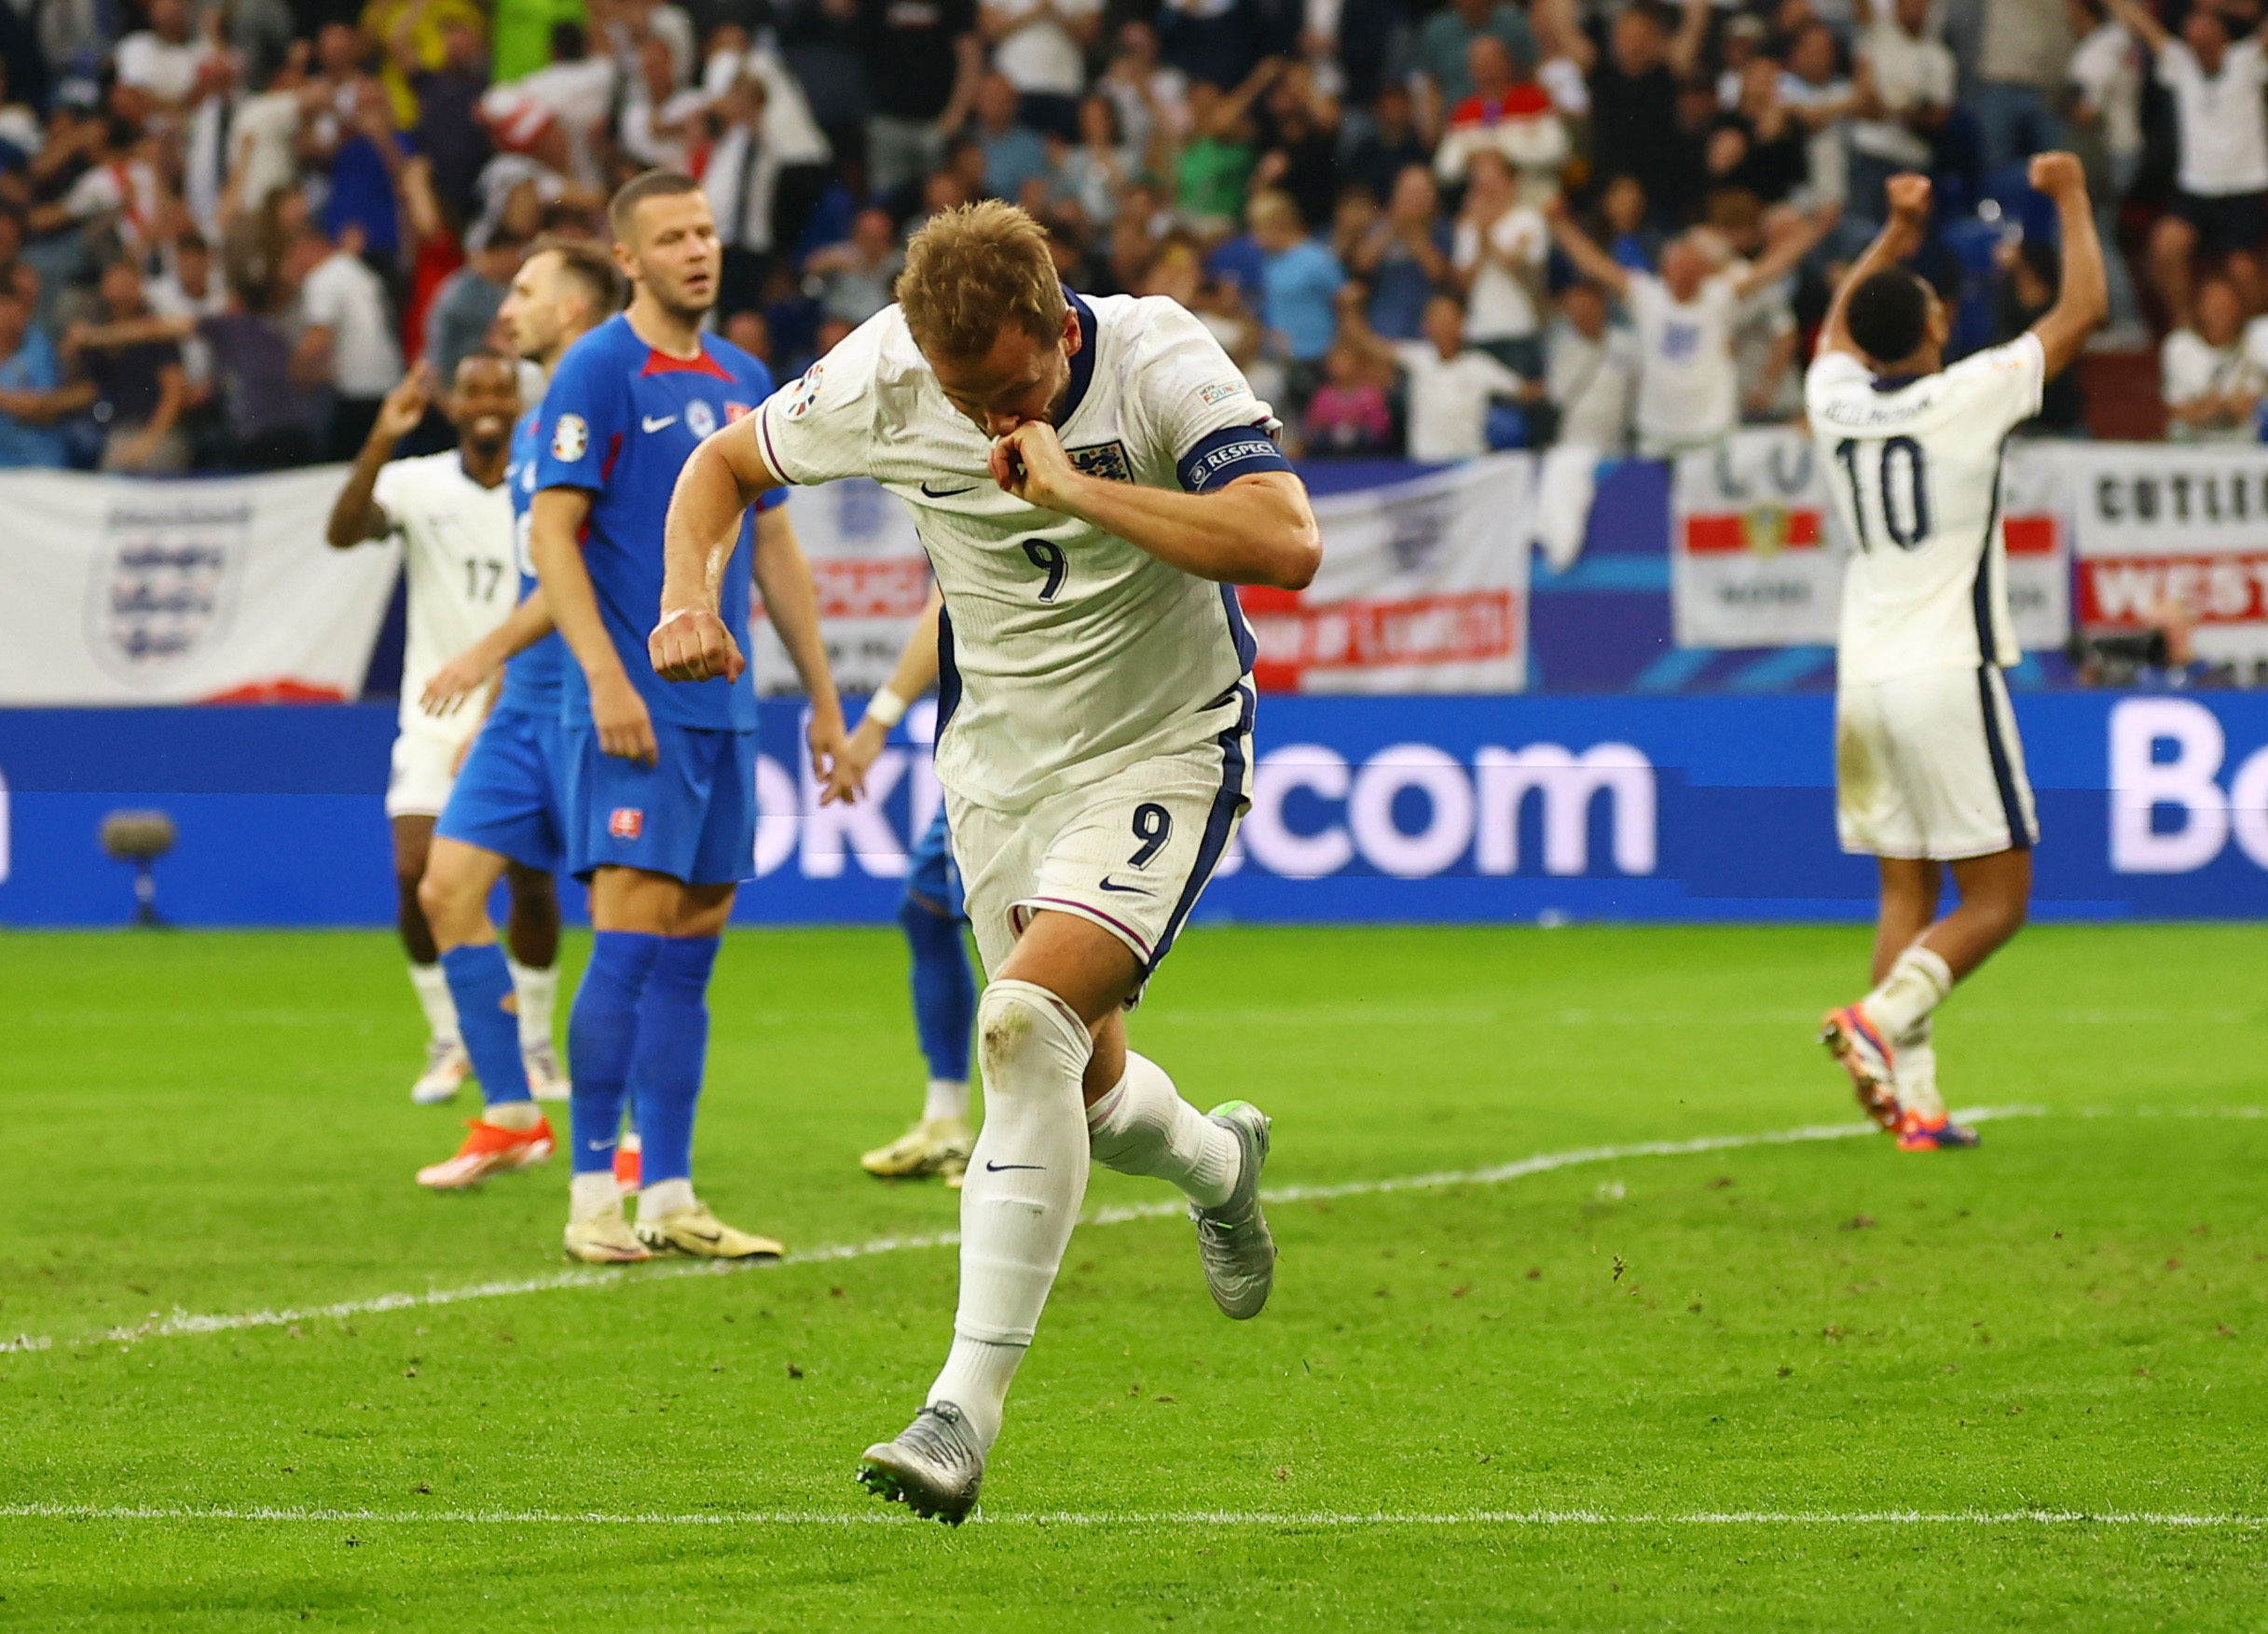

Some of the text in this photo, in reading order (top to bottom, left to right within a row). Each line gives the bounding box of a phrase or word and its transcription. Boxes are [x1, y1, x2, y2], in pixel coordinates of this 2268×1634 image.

[1207, 443, 1276, 468] RESPECT
[1835, 435, 1931, 555] 10
[465, 558, 503, 603] 17
[1023, 538, 1069, 604] 9
[1126, 803, 1174, 872] 9
